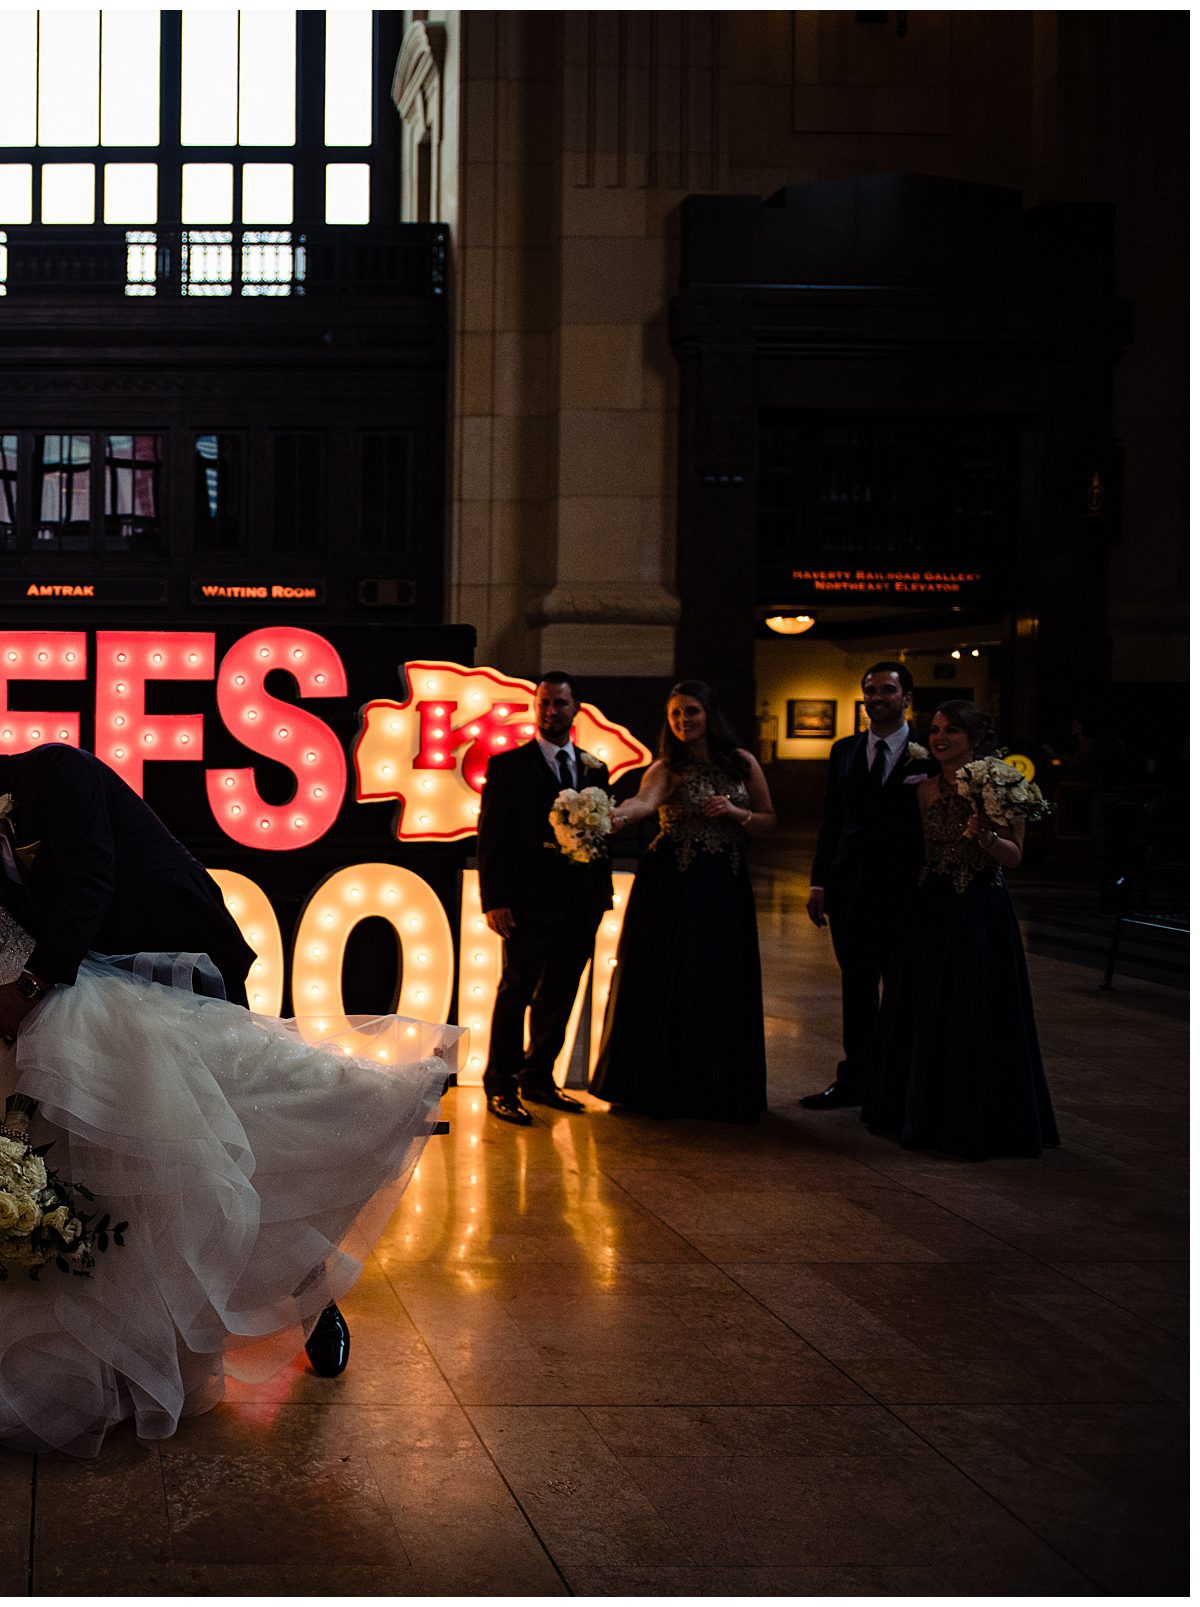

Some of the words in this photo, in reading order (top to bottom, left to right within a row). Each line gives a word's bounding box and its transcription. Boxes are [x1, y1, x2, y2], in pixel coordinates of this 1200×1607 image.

[26, 583, 95, 597] AMTRAK
[202, 585, 268, 599] WAITING
[271, 585, 317, 599] ROOM
